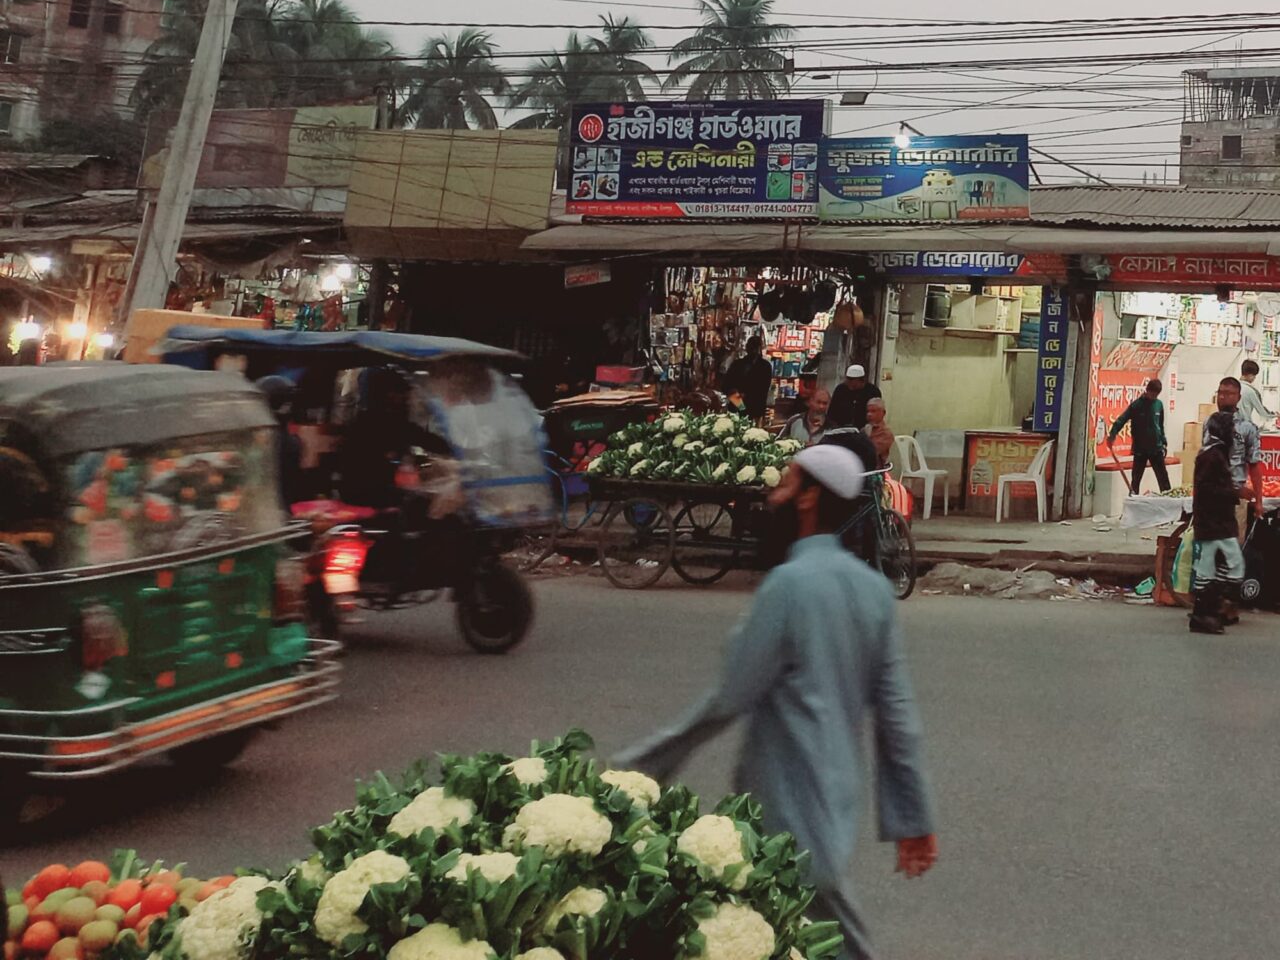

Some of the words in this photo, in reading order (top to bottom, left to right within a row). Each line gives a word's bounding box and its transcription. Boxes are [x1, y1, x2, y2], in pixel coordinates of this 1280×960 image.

[607, 105, 694, 140] হাজীগঞ্জ
[699, 109, 802, 141] হার্ডওয়্যার
[667, 140, 757, 171] মেশিনারী
